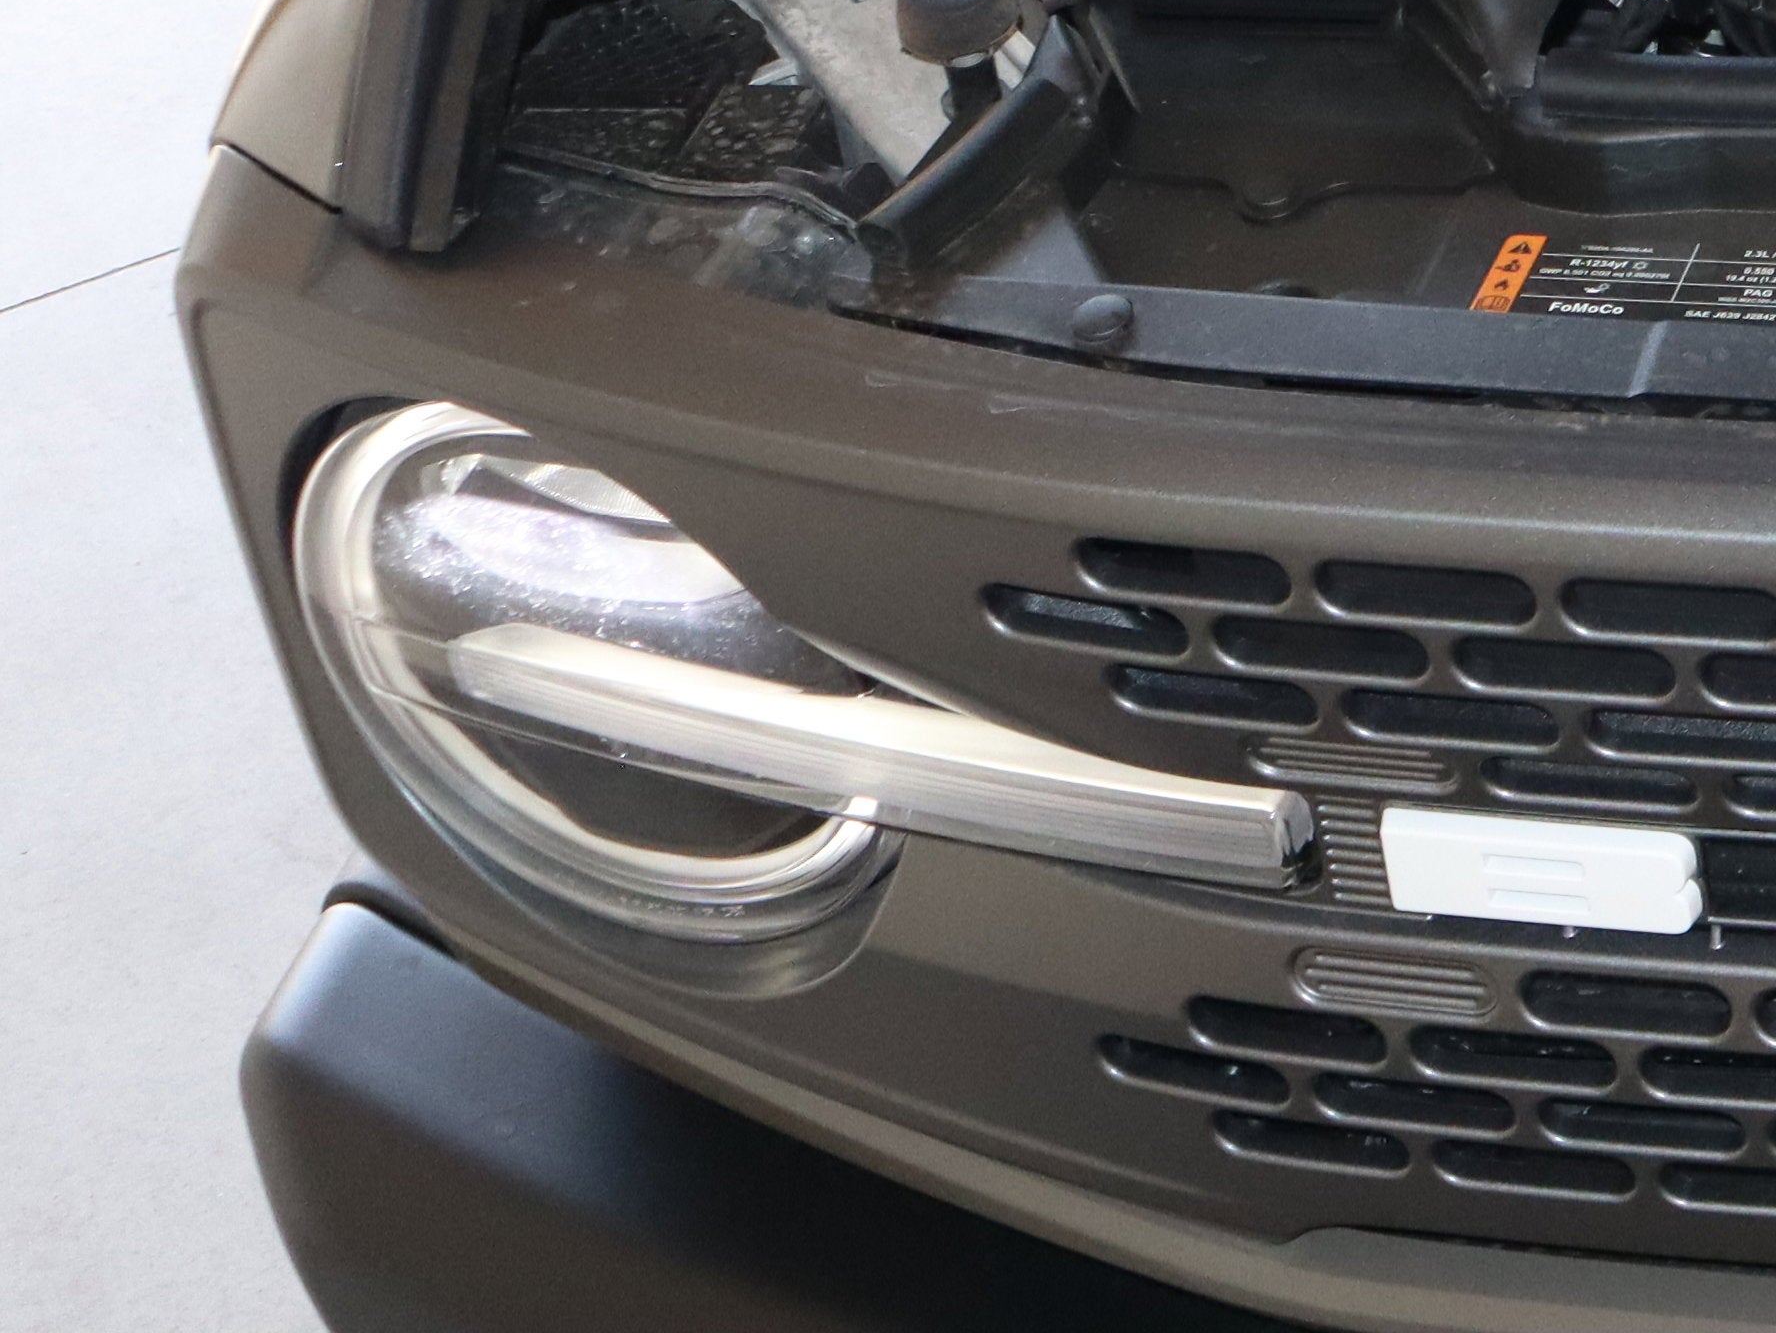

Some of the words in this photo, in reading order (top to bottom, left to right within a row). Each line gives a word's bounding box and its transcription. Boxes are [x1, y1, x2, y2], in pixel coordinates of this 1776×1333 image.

[1569, 258, 1630, 270] R-1234yf
[1548, 301, 1625, 315] FoMoCo
[1683, 309, 1711, 319] SAE
